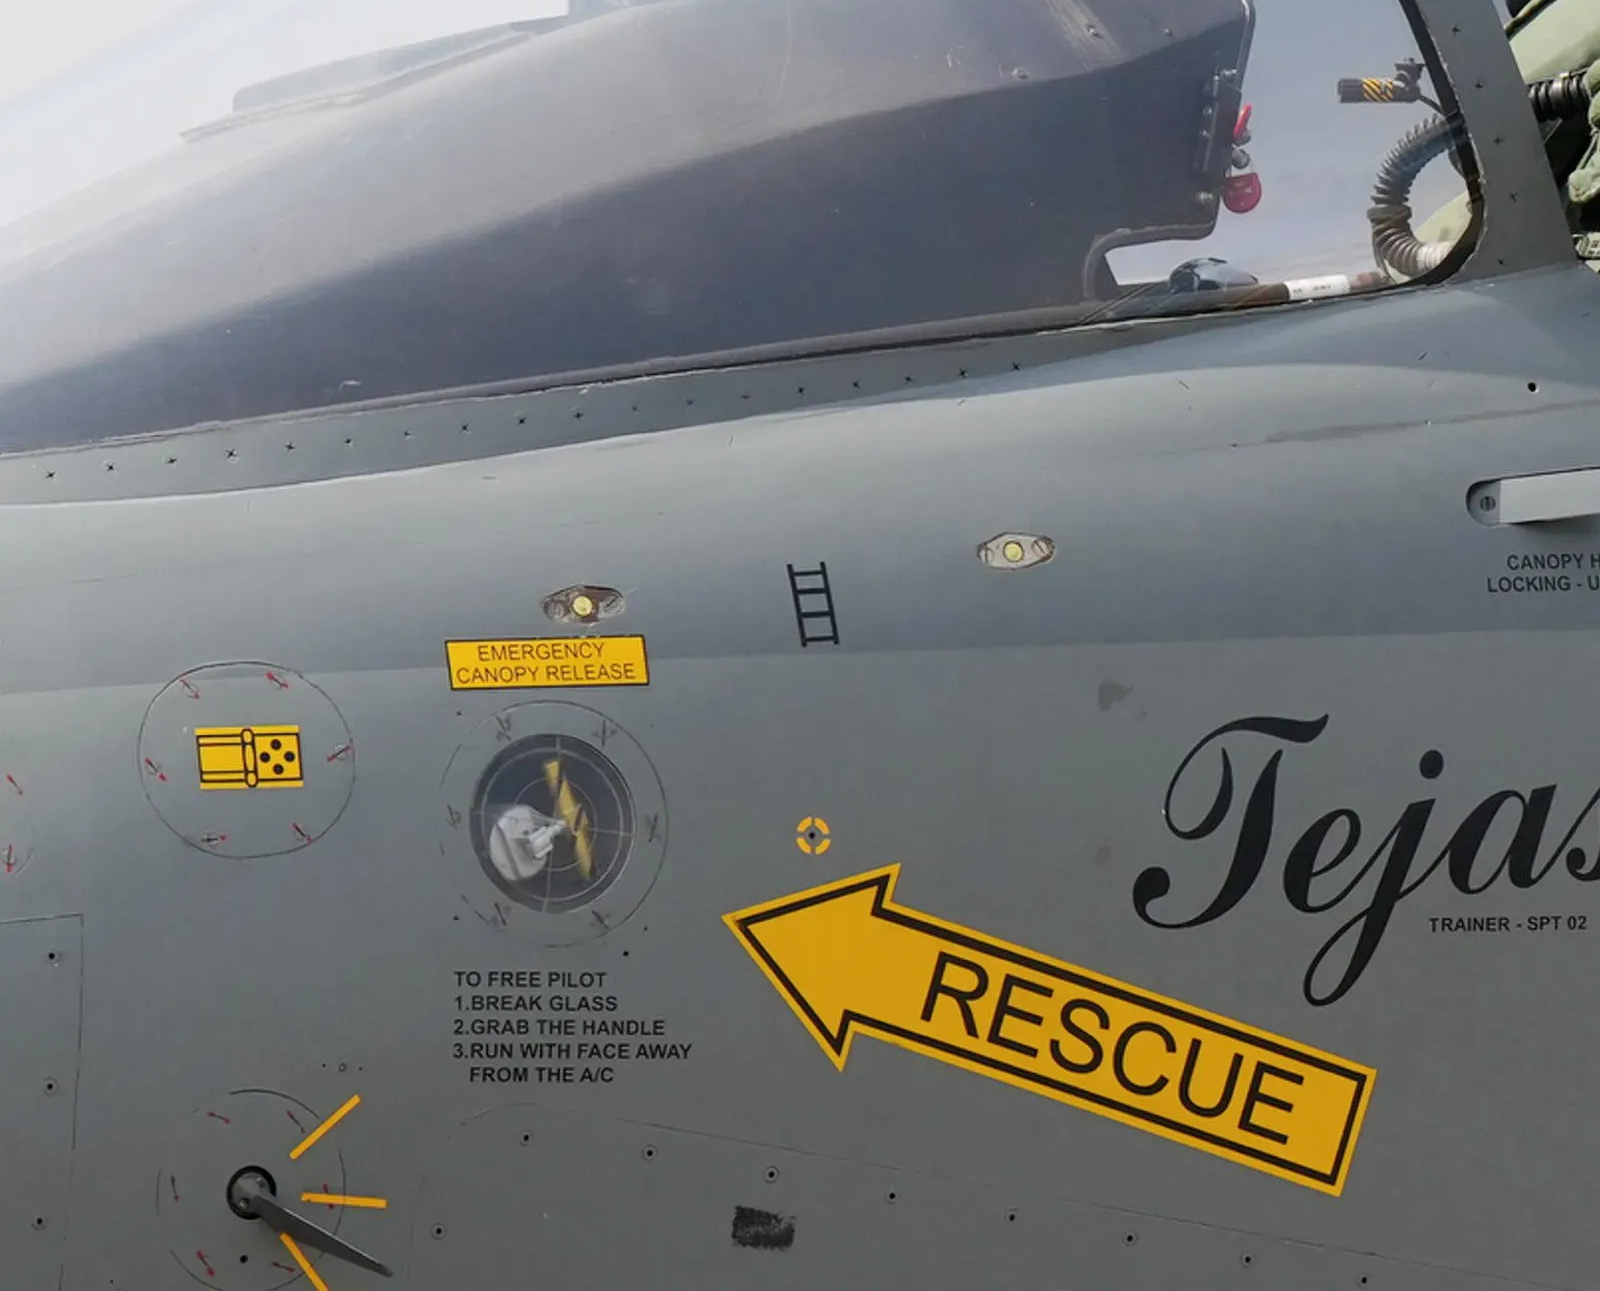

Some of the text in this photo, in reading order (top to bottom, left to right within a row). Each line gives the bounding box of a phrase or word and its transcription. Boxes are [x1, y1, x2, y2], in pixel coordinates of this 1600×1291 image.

[1506, 553, 1585, 571] CANOPY
[1487, 574, 1571, 593] LOCKING
[477, 641, 605, 662] EMERGENCY
[456, 662, 637, 685] CANOPY RELEASE
[1428, 917, 1511, 933] TRAINER
[1526, 915, 1562, 931] SPT
[1567, 915, 1588, 930] 02
[453, 971, 608, 988] TO FREE PILOT
[454, 995, 618, 1012] 1.BREAK GLASS
[453, 1019, 666, 1036] 2.GRAB THE HANDLE
[453, 1042, 693, 1060] 3.RUN WITH FACE AWAY
[920, 951, 1305, 1146] RESCUE
[469, 1066, 615, 1083] FROM THE A/C
